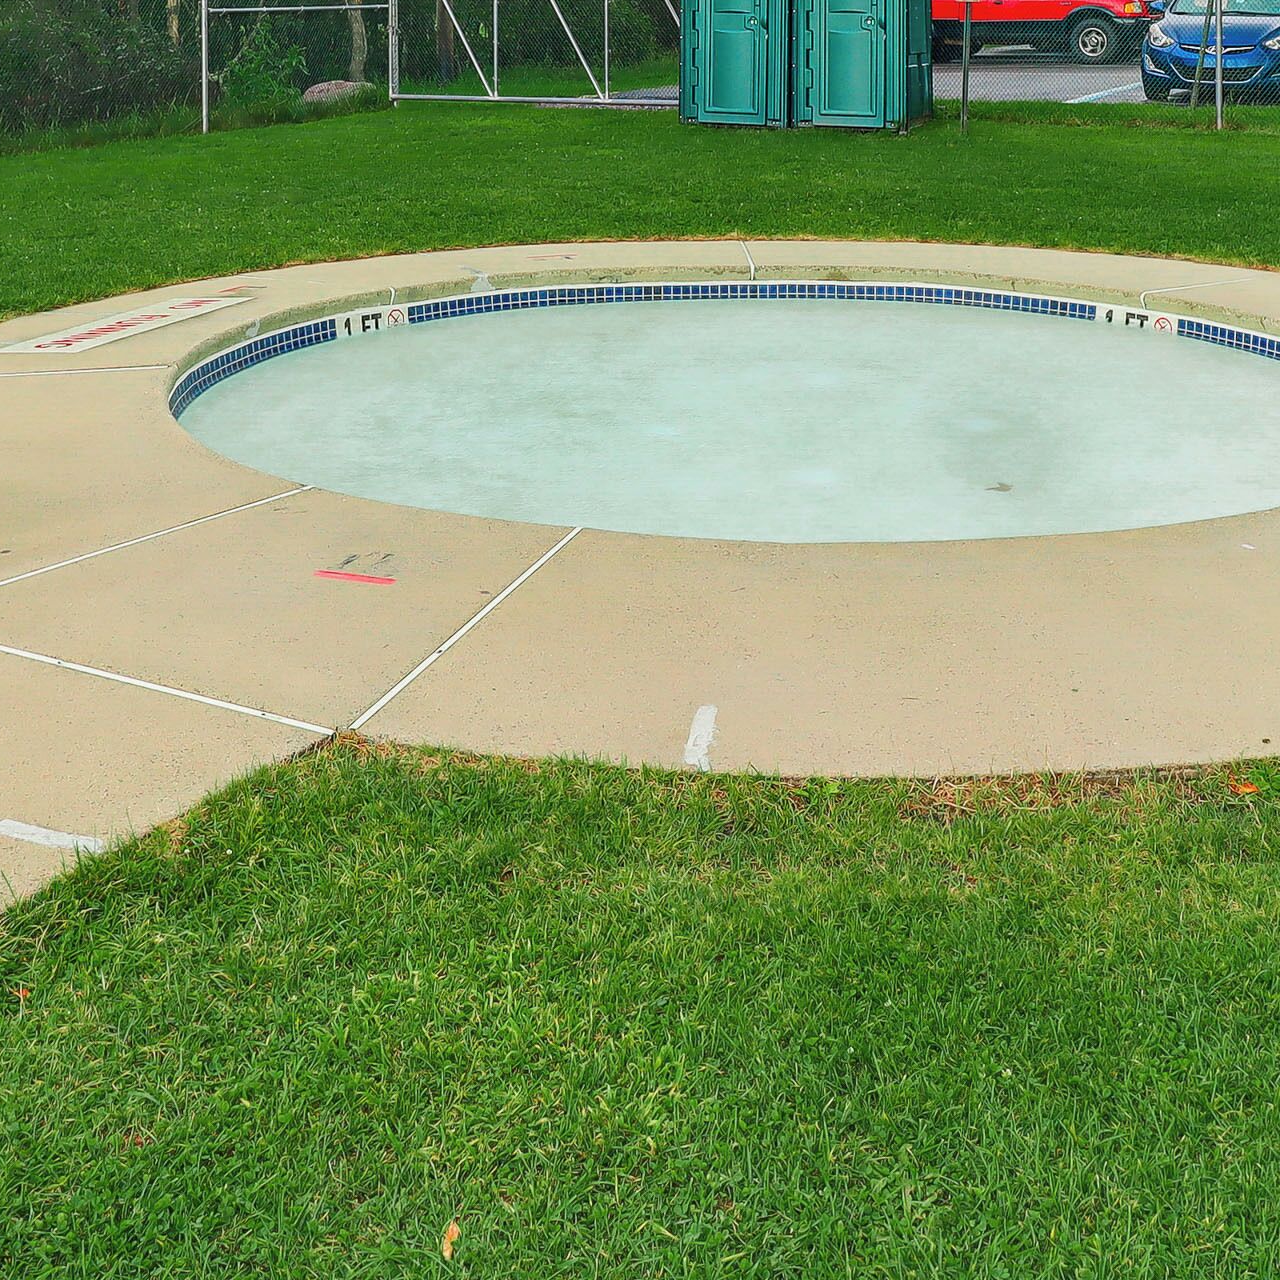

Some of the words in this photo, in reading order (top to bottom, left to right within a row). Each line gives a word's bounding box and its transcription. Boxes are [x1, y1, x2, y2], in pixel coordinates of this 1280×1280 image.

[169, 299, 222, 310] NO
[35, 314, 171, 349] RUNNING
[344, 317, 352, 336] 1
[361, 312, 382, 333] FT
